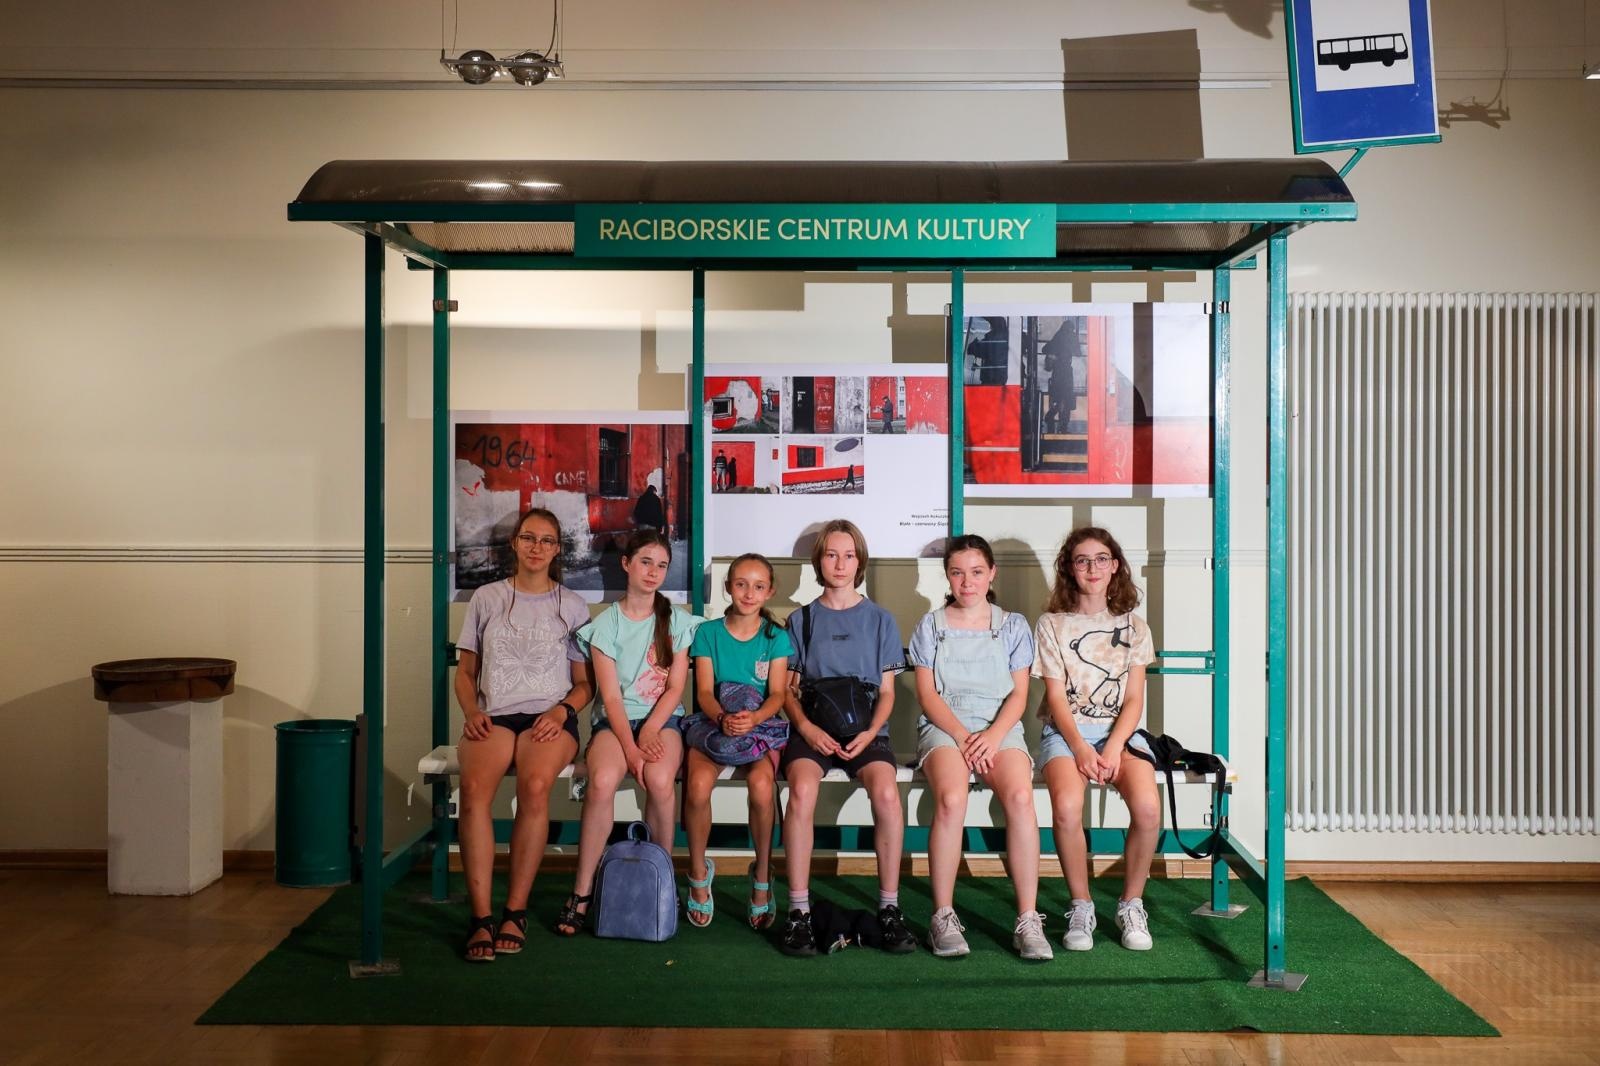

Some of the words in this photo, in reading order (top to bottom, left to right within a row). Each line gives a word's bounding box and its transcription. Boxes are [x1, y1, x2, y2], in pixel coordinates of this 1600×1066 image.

[600, 218, 771, 241] RACIBORSKIE
[778, 218, 909, 241] CENTRUM
[917, 218, 1032, 241] KULTURY
[472, 434, 537, 469] 1964
